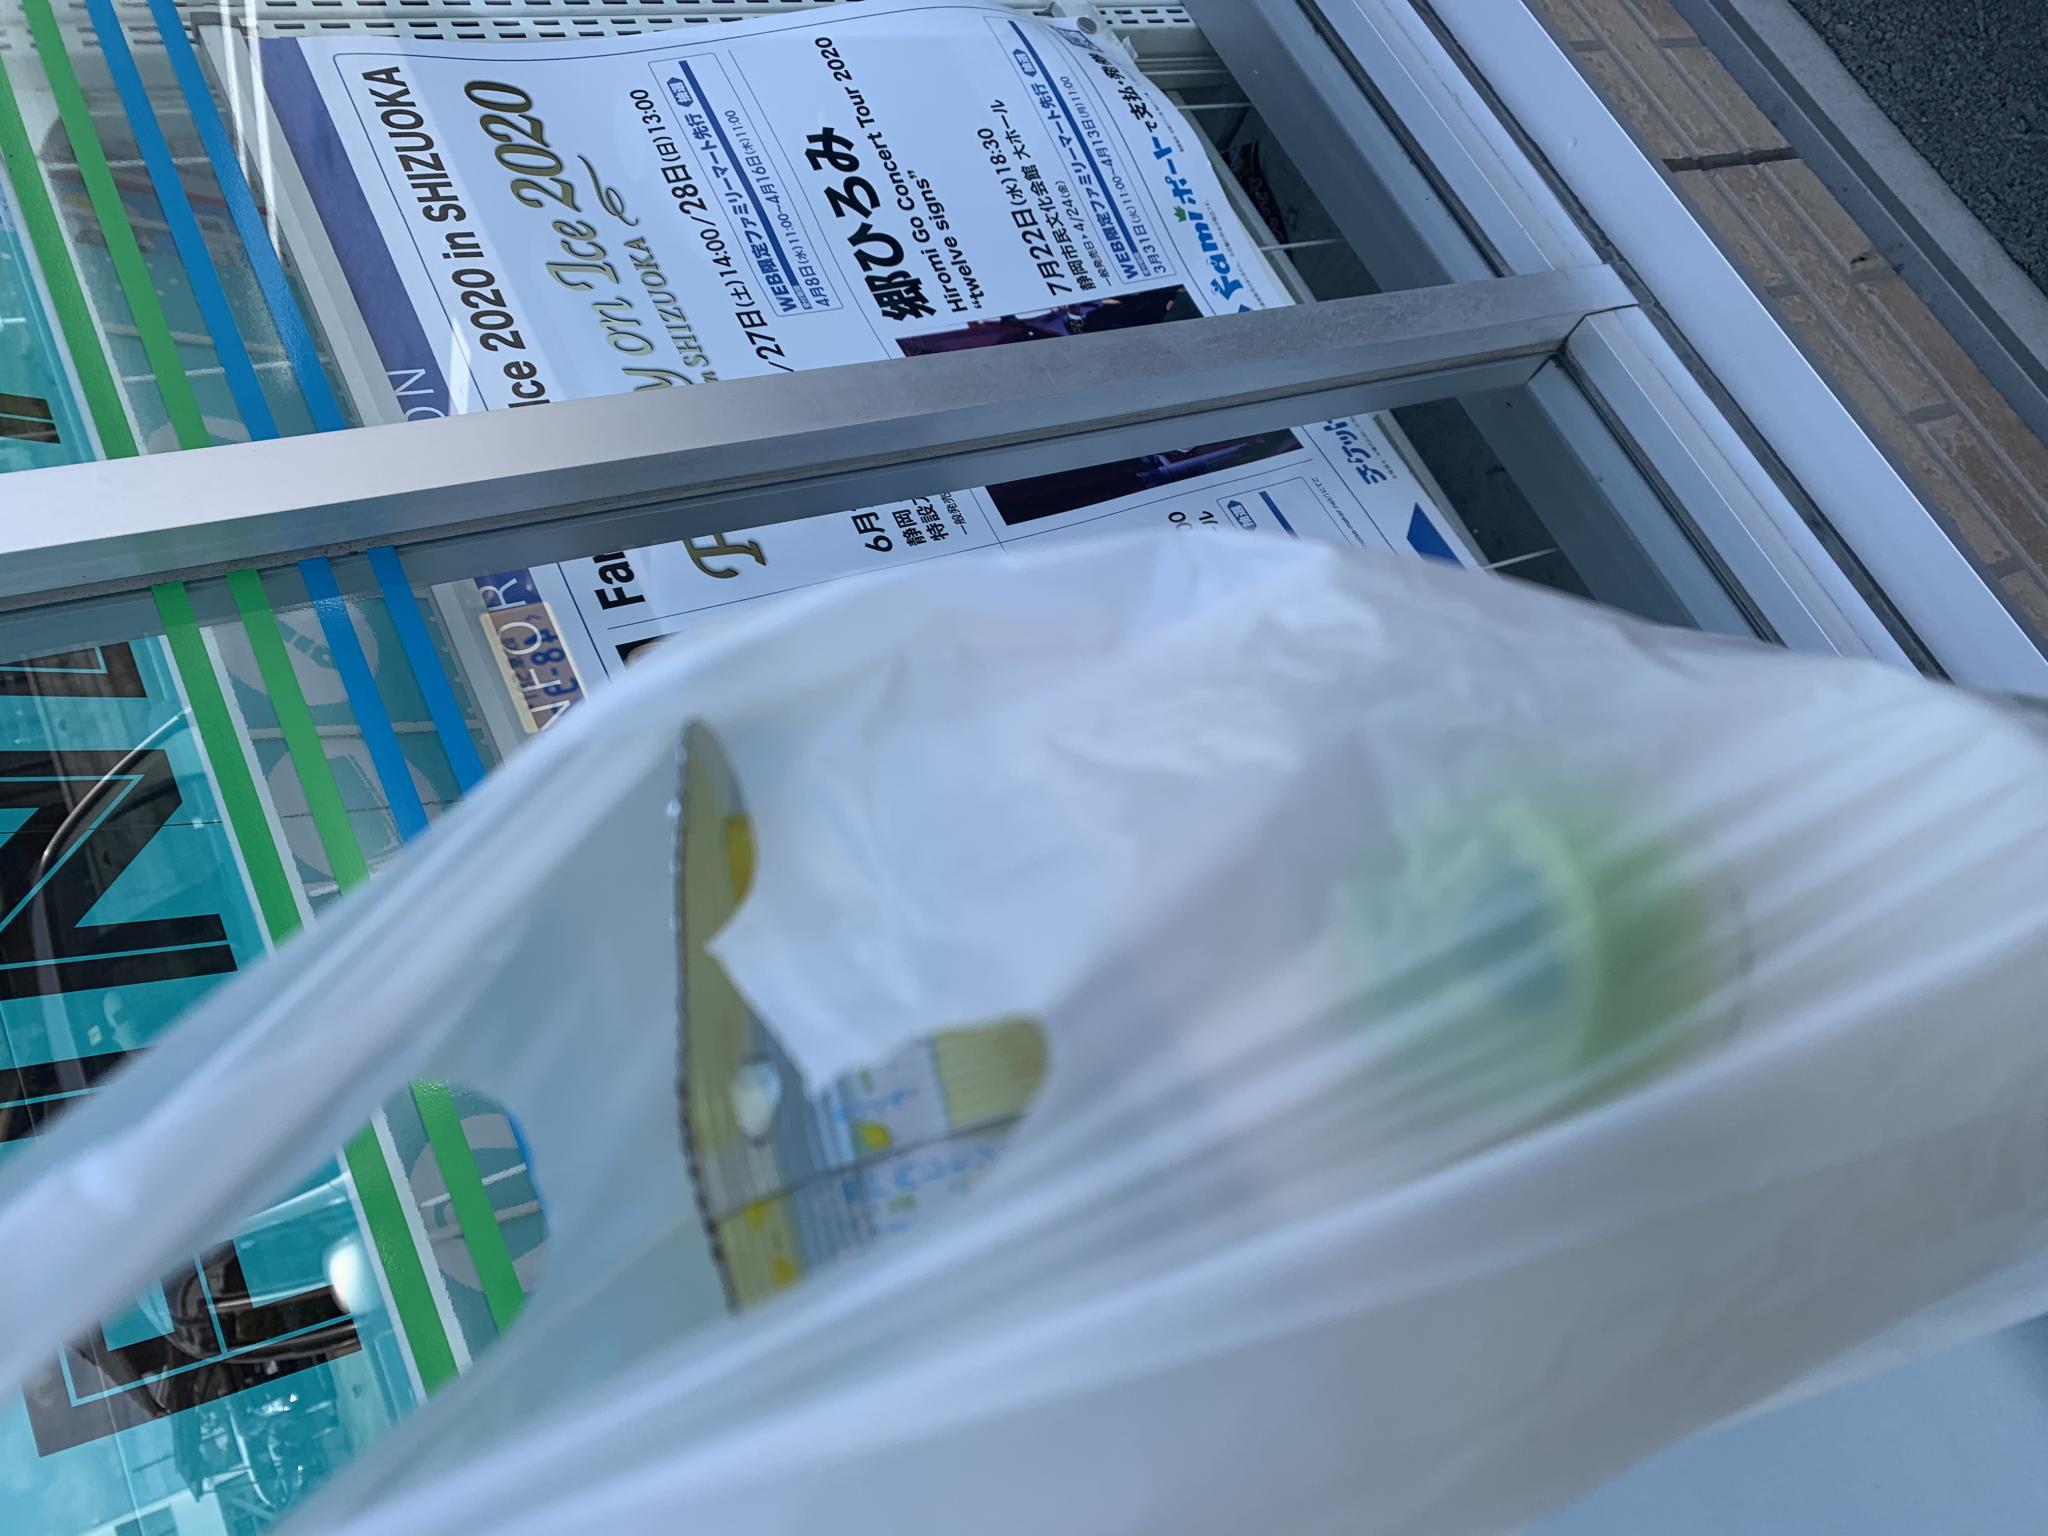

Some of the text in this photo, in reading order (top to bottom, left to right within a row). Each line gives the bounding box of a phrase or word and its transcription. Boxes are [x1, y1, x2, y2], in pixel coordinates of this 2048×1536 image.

[362, 66, 467, 224] SHIZUOKA
[464, 80, 582, 212] 2020
[815, 37, 967, 314] Hiromi Go Concert Tour 2020
[990, 99, 1097, 290] 静岡市民文化会館 大ホール
[1028, 82, 1138, 280] WEB限定ファミリーマート先行
[442, 230, 485, 260] in
[545, 220, 620, 291] Ice
[680, 113, 798, 314] WEB限定ファミリーマート先行
[805, 126, 937, 322] 郷ひろみ
[452, 268, 528, 352] 2020
[593, 297, 655, 357] on
[618, 235, 712, 371] SHIZUOKA
[507, 359, 551, 408] Ice
